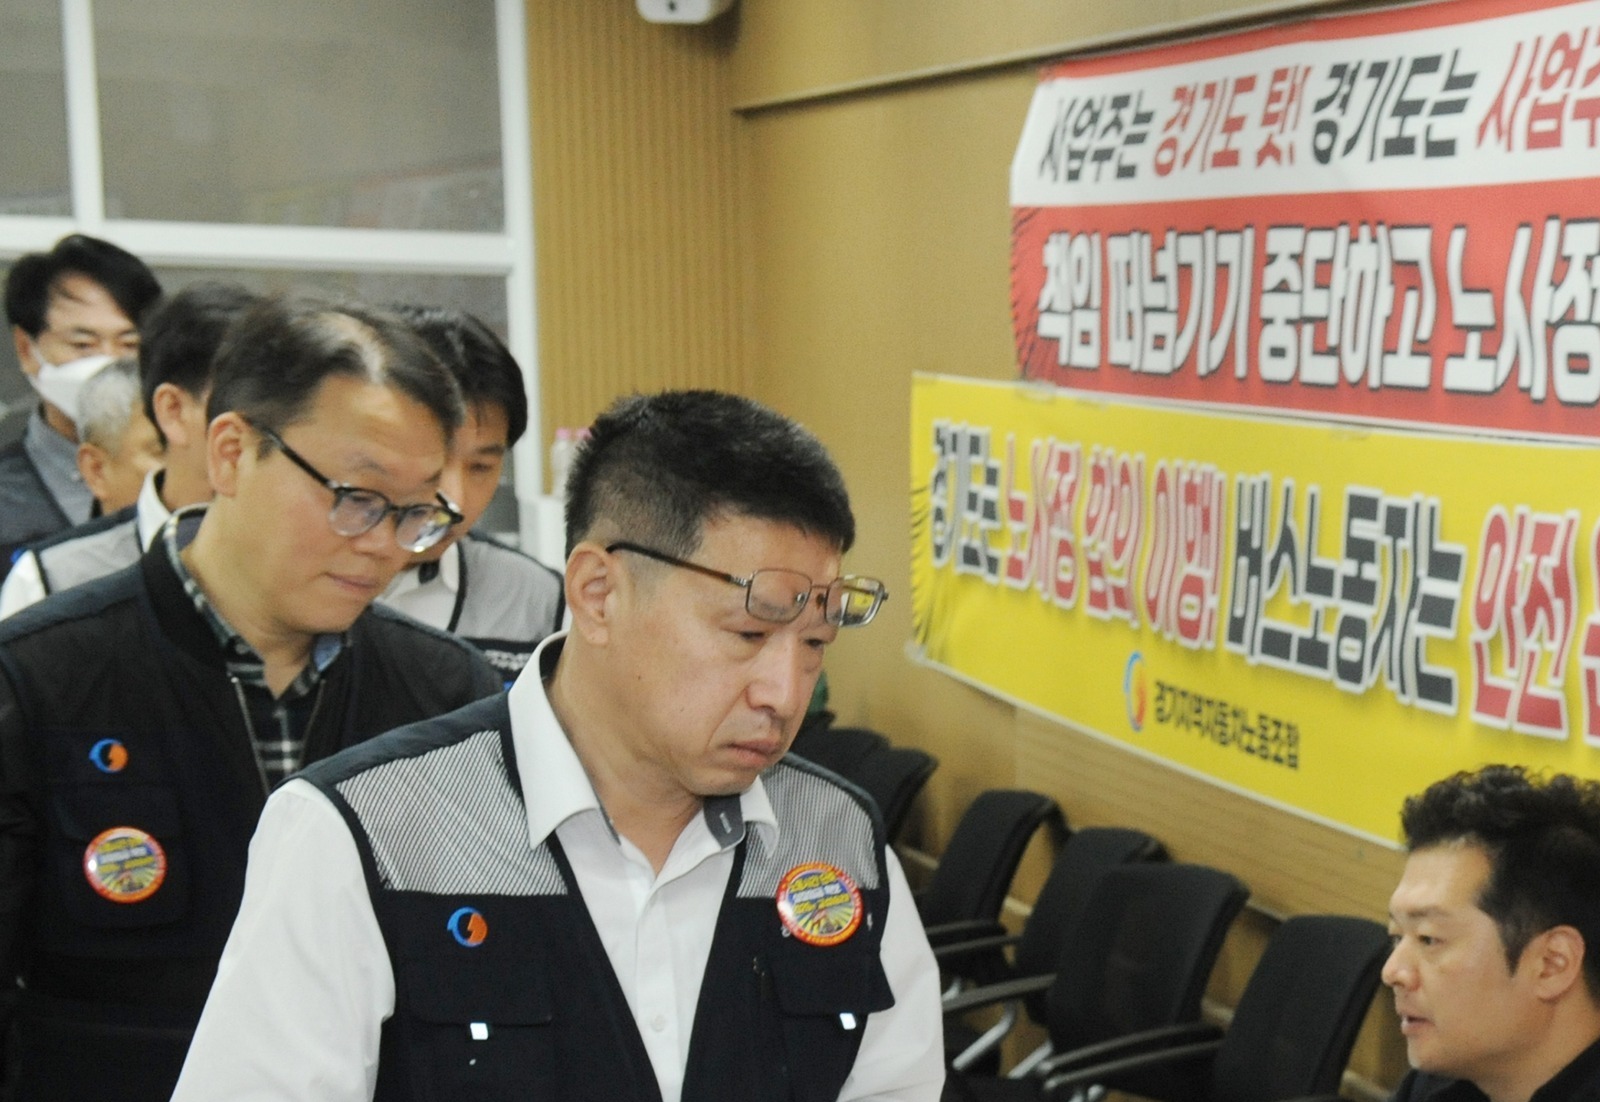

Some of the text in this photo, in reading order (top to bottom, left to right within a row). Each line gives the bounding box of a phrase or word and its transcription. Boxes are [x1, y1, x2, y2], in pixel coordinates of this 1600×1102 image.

[1039, 89, 1154, 183] 사업주는
[1154, 74, 1258, 177] 경기도
[1256, 65, 1312, 168] 탓!
[1312, 48, 1480, 166] 경기도는
[1037, 230, 1102, 371] 책임
[1106, 225, 1256, 380] 떠넘기기
[1257, 221, 1435, 389] 중단하고
[932, 420, 1002, 586] 경기도는
[1004, 433, 1083, 609] 노사정
[1084, 445, 1146, 631] 합의
[1144, 458, 1226, 651] 이행!
[1225, 472, 1467, 716] 버스노동자는
[1470, 502, 1580, 740] 안전
